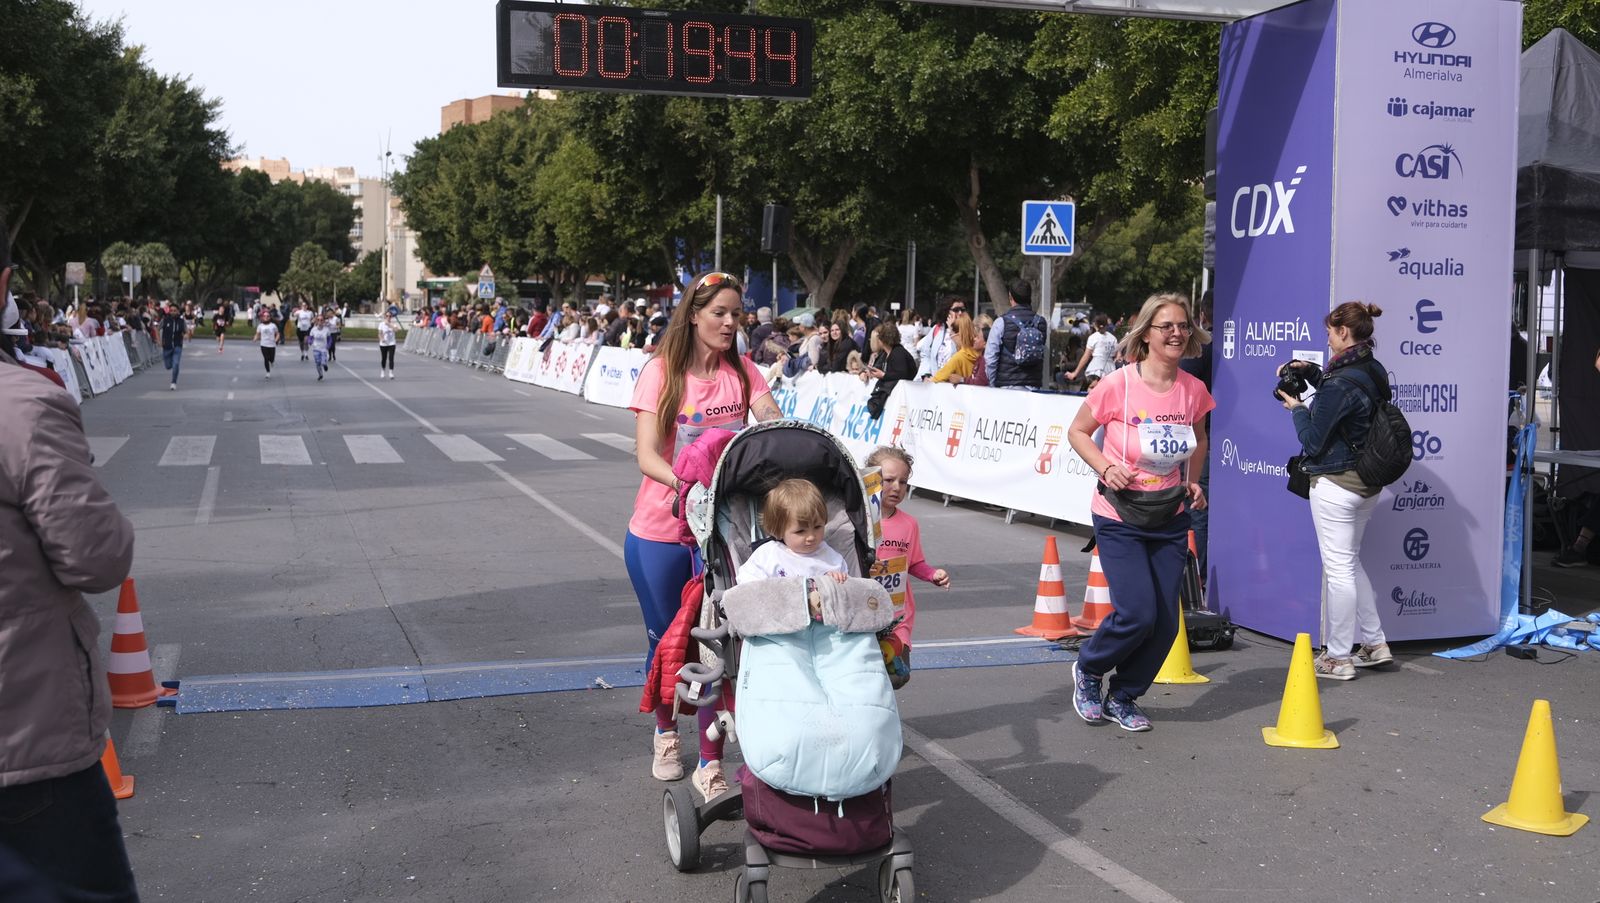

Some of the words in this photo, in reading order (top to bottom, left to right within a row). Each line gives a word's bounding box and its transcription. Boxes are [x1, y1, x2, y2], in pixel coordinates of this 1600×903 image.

[554, 13, 797, 86] 00:19:44
[1394, 51, 1472, 68] HYUNDAI
[1403, 67, 1463, 82] Almerialva
[1412, 101, 1475, 120] cajamar
[1395, 153, 1450, 180] CASI
[1231, 166, 1307, 239] CDX
[1412, 199, 1468, 217] vithas
[1441, 221, 1468, 229] cuidarte
[1398, 258, 1464, 280] aqualia
[1245, 317, 1311, 341] ALMERÍA
[1245, 344, 1276, 356] CIUDAD
[1400, 340, 1442, 355] Clece
[1399, 382, 1421, 397] AARÓN
[1423, 384, 1457, 412] CASH
[1156, 412, 1185, 422] conviv
[973, 418, 1038, 448] ALMERÍA
[970, 444, 1002, 462] CIUDAD
[1150, 439, 1189, 454] 1304
[1411, 430, 1442, 461] go
[1067, 458, 1099, 478] CIUDA
[1221, 439, 1290, 478] MujerAlmerí
[1392, 494, 1445, 511] Lanjarón
[1391, 586, 1436, 616] Galatea
